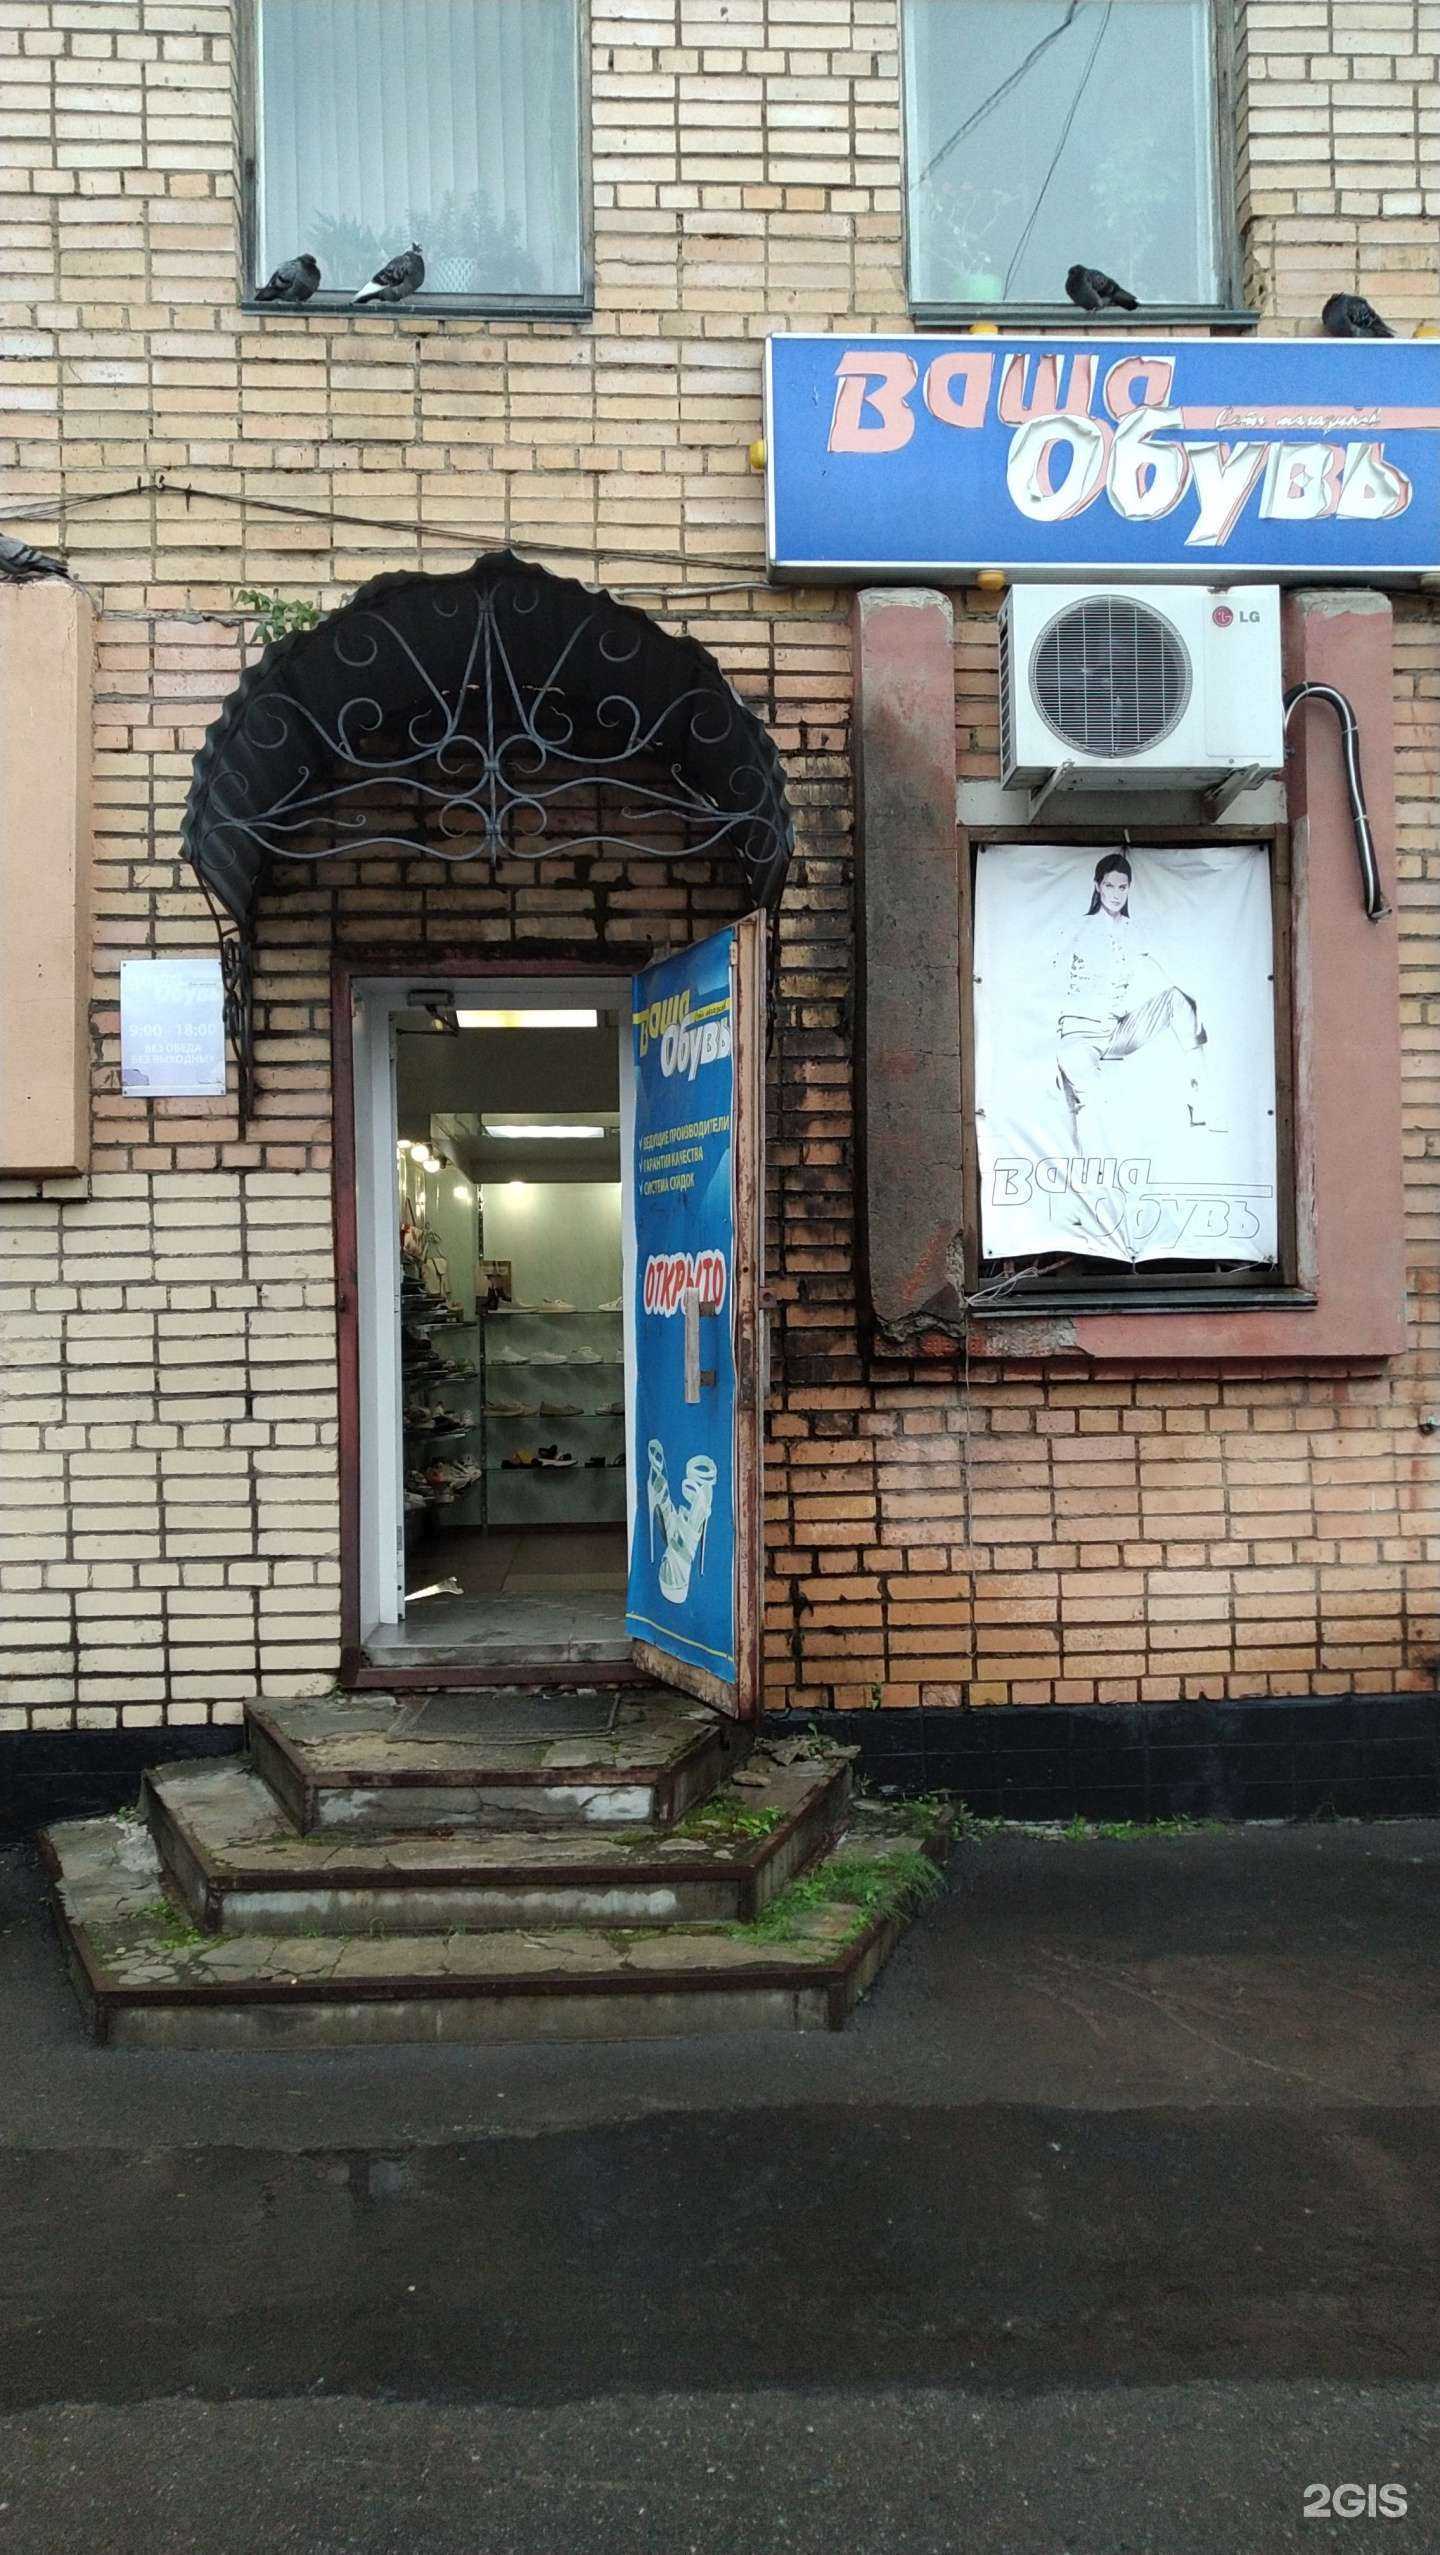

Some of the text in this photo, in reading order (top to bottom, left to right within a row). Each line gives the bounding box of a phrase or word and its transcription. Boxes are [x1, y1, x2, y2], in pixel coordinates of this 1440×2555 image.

[828, 351, 1177, 453] Ваша
[1006, 406, 1413, 547] Обувь
[1239, 610, 1261, 623] LG
[660, 1013, 732, 1082] Обувь
[669, 1115, 730, 1143] ПРОИЗВОДИТЕЛИ
[671, 1145, 704, 1167] КАЧЕСТВА
[991, 1157, 1152, 1206] Ваша
